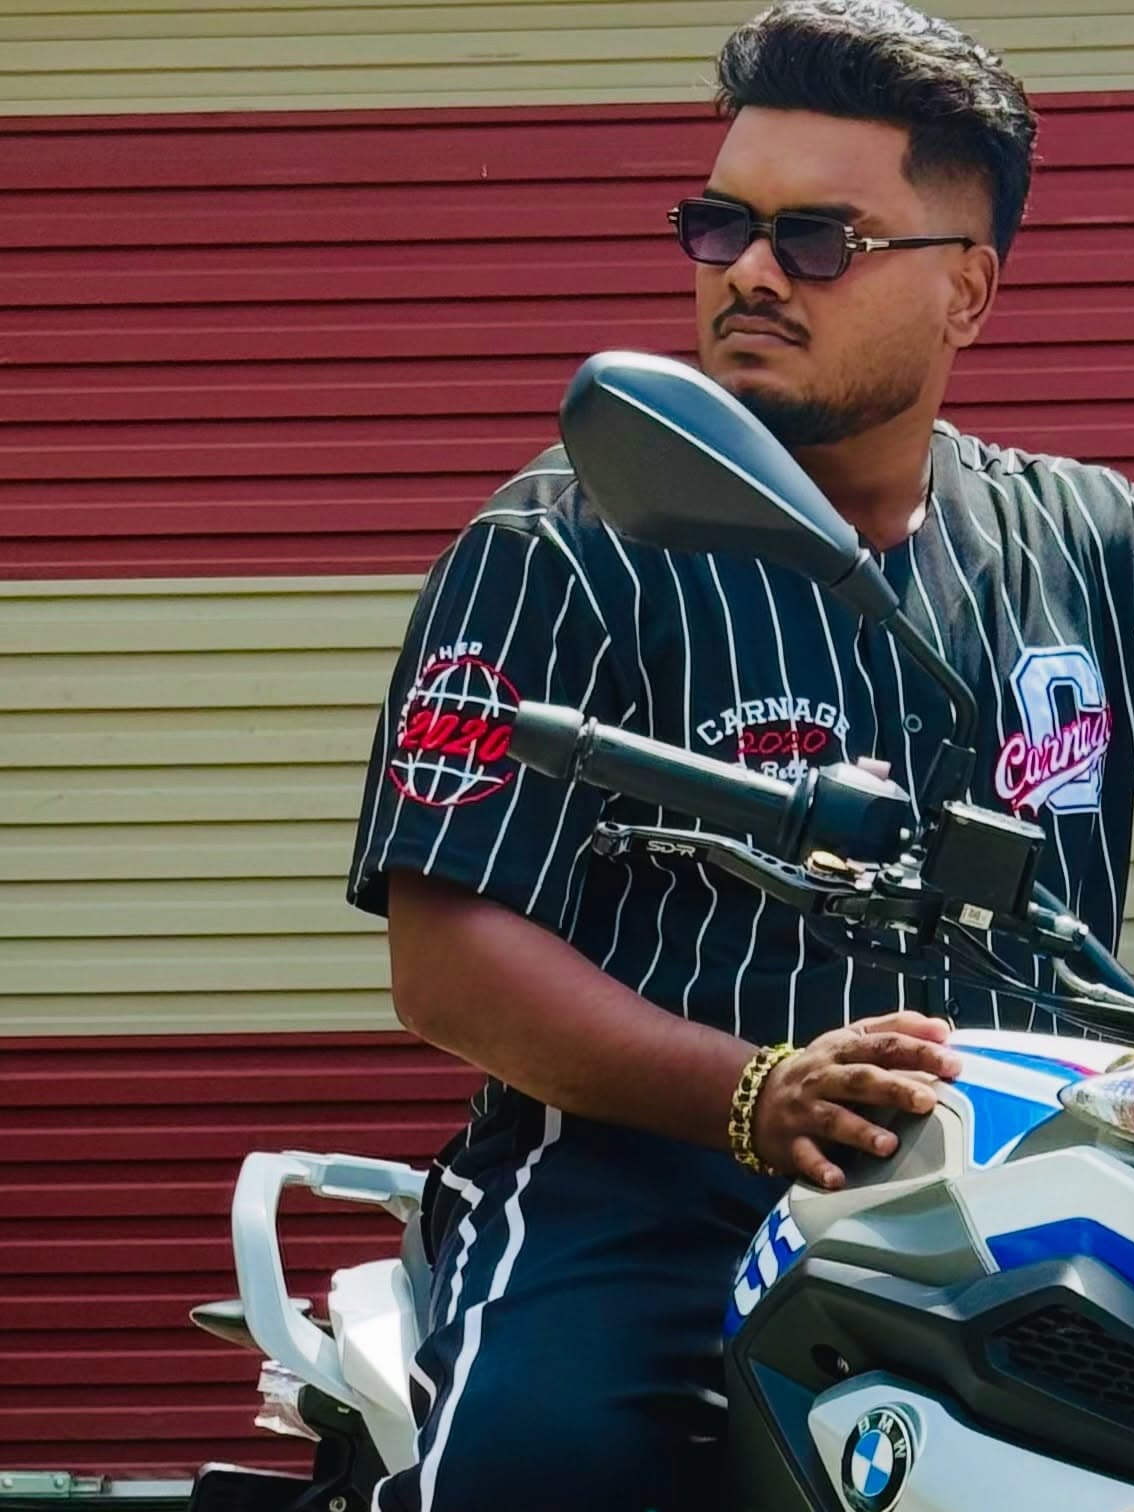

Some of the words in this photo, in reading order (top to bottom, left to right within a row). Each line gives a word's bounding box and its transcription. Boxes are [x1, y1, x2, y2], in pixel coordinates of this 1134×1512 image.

[402, 709, 513, 763] 2020
[696, 696, 850, 746] CARNAGE
[736, 728, 829, 756] 2020
[857, 1412, 908, 1460] BMW
